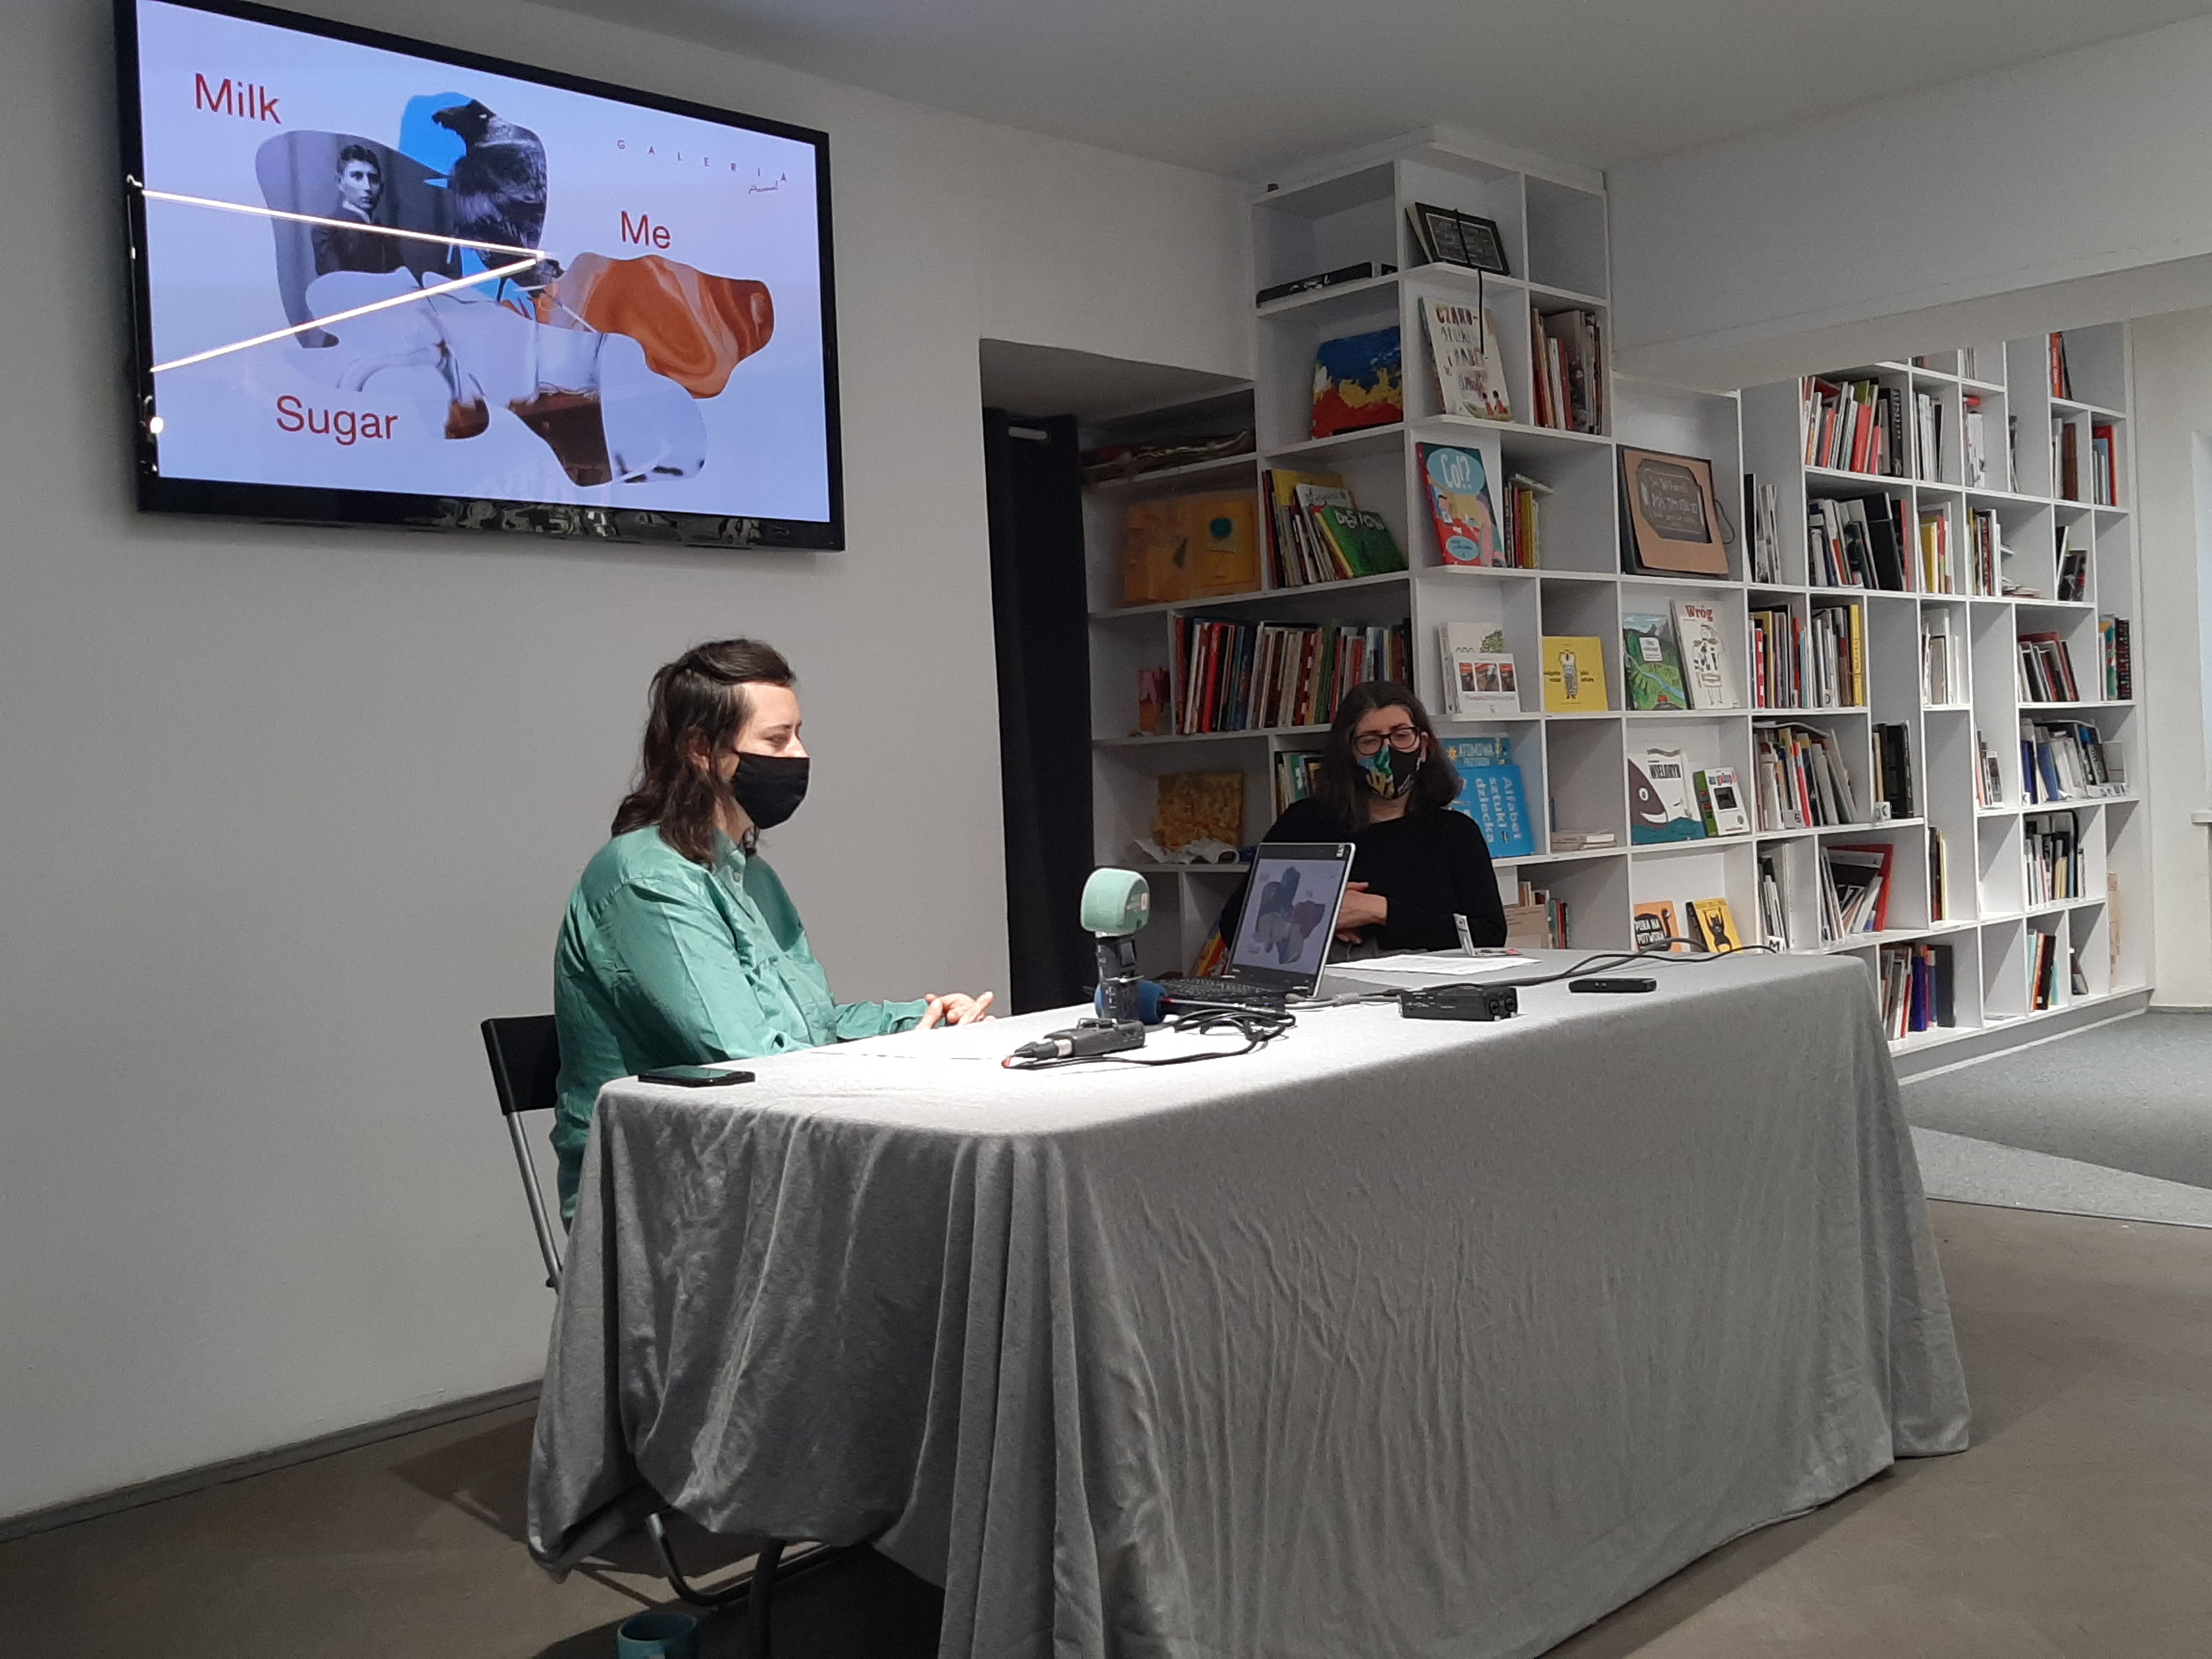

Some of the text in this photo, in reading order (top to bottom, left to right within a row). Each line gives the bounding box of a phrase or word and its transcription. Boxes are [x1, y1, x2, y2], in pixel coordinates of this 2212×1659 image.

[195, 72, 281, 125] Milk
[617, 139, 787, 182] GALERIA
[620, 210, 671, 249] Me
[276, 395, 398, 446] Sugar
